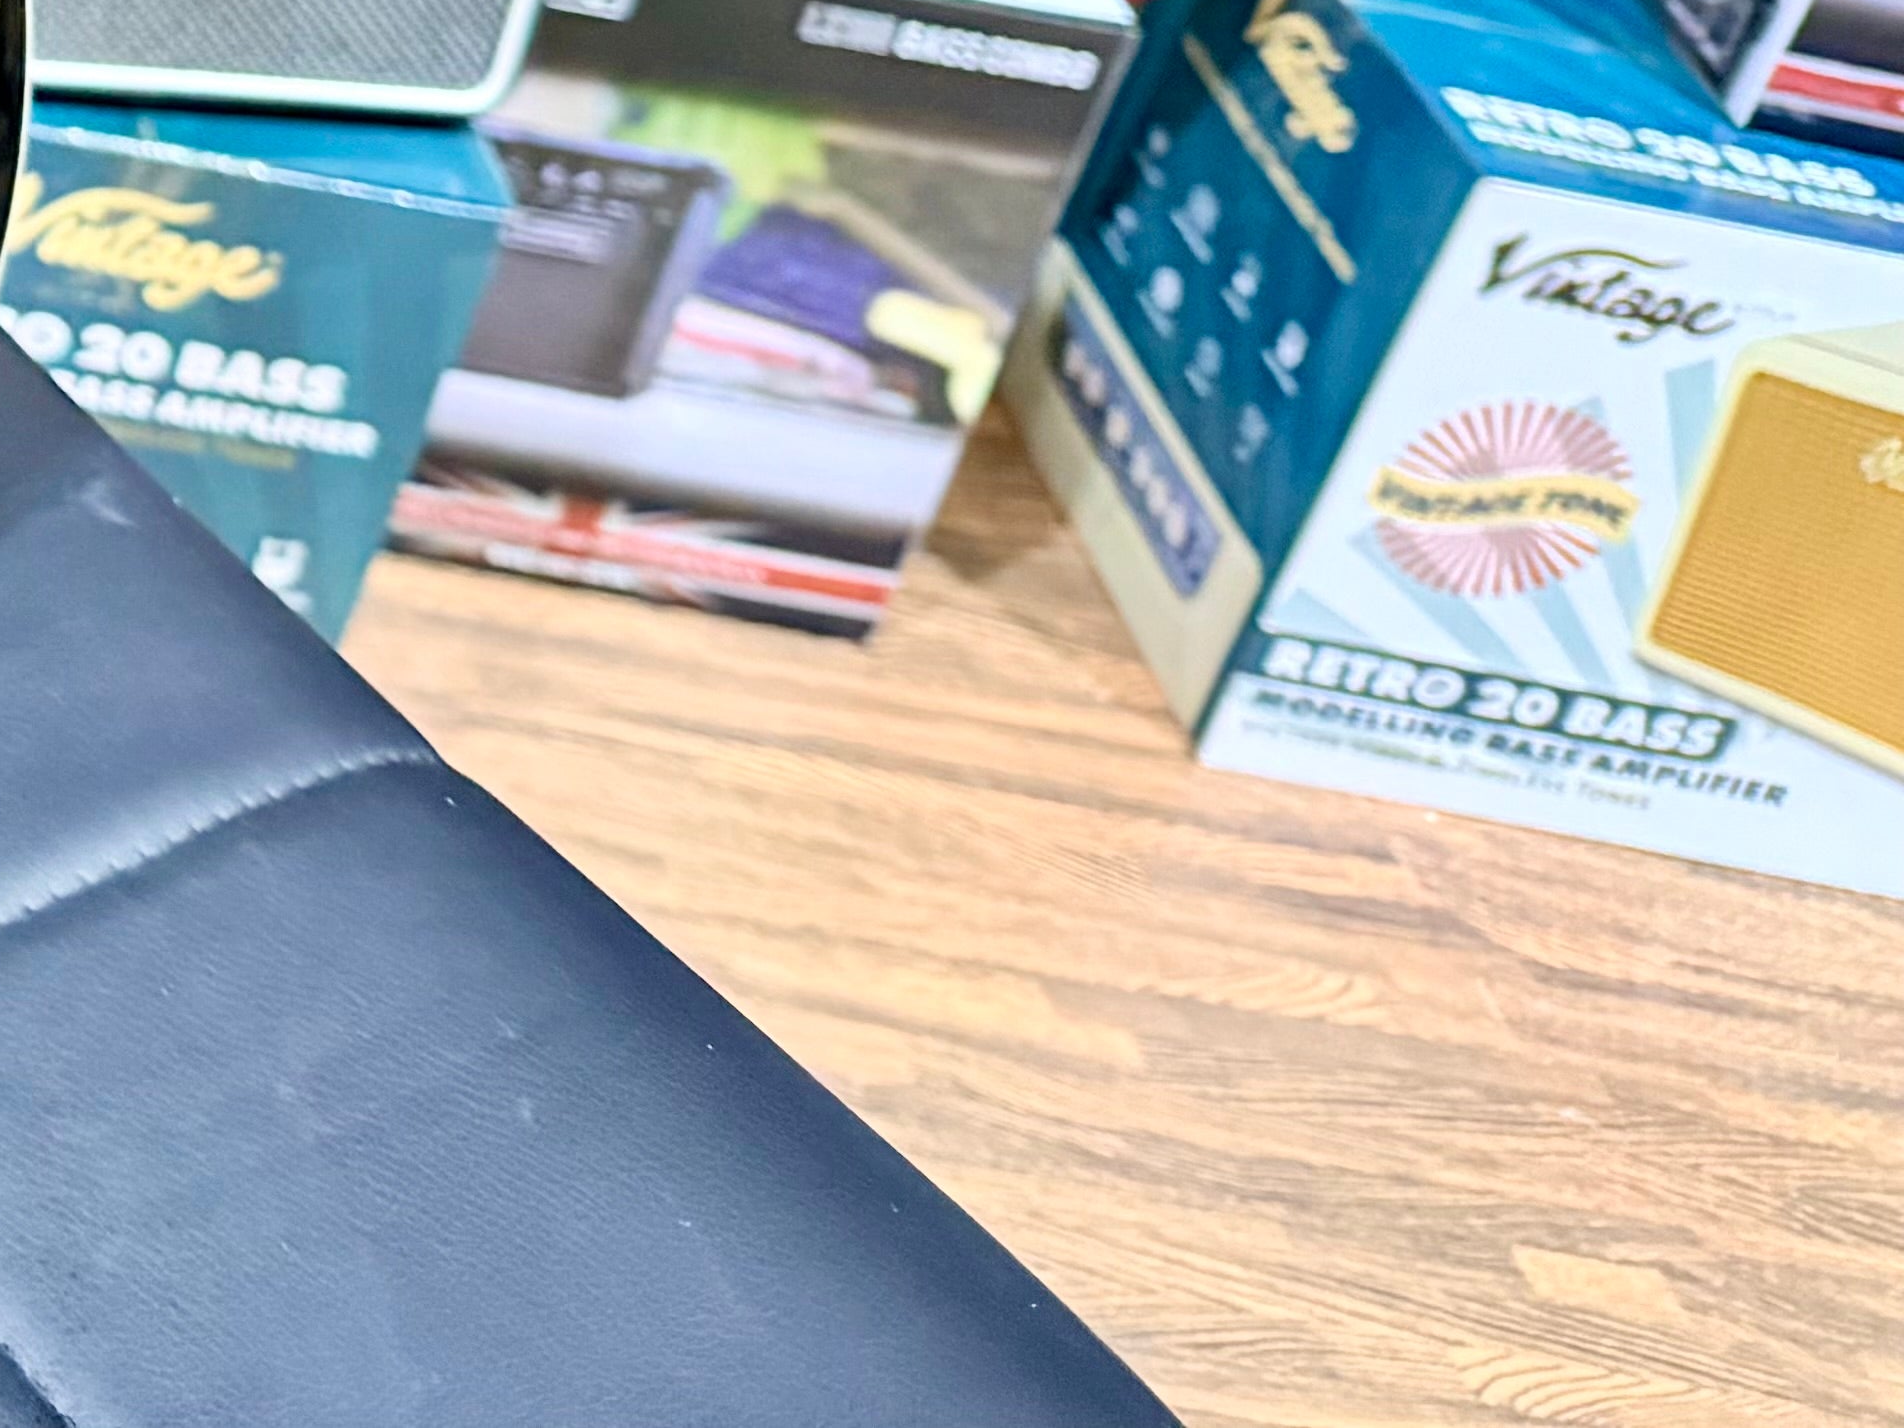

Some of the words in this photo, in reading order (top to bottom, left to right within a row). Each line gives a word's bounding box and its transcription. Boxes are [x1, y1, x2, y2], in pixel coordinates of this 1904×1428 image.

[4, 172, 286, 312] Vintage
[1481, 232, 1738, 344] Vintage
[72, 323, 174, 383] 20
[174, 340, 349, 414] BASS
[1251, 689, 1478, 746] MODELLING
[1486, 732, 1584, 768] BASS
[1594, 750, 1789, 809] AMPLIFIER
[1261, 638, 1467, 710] RETRO
[1468, 678, 1562, 728] 20
[1564, 694, 1728, 756] BASS
